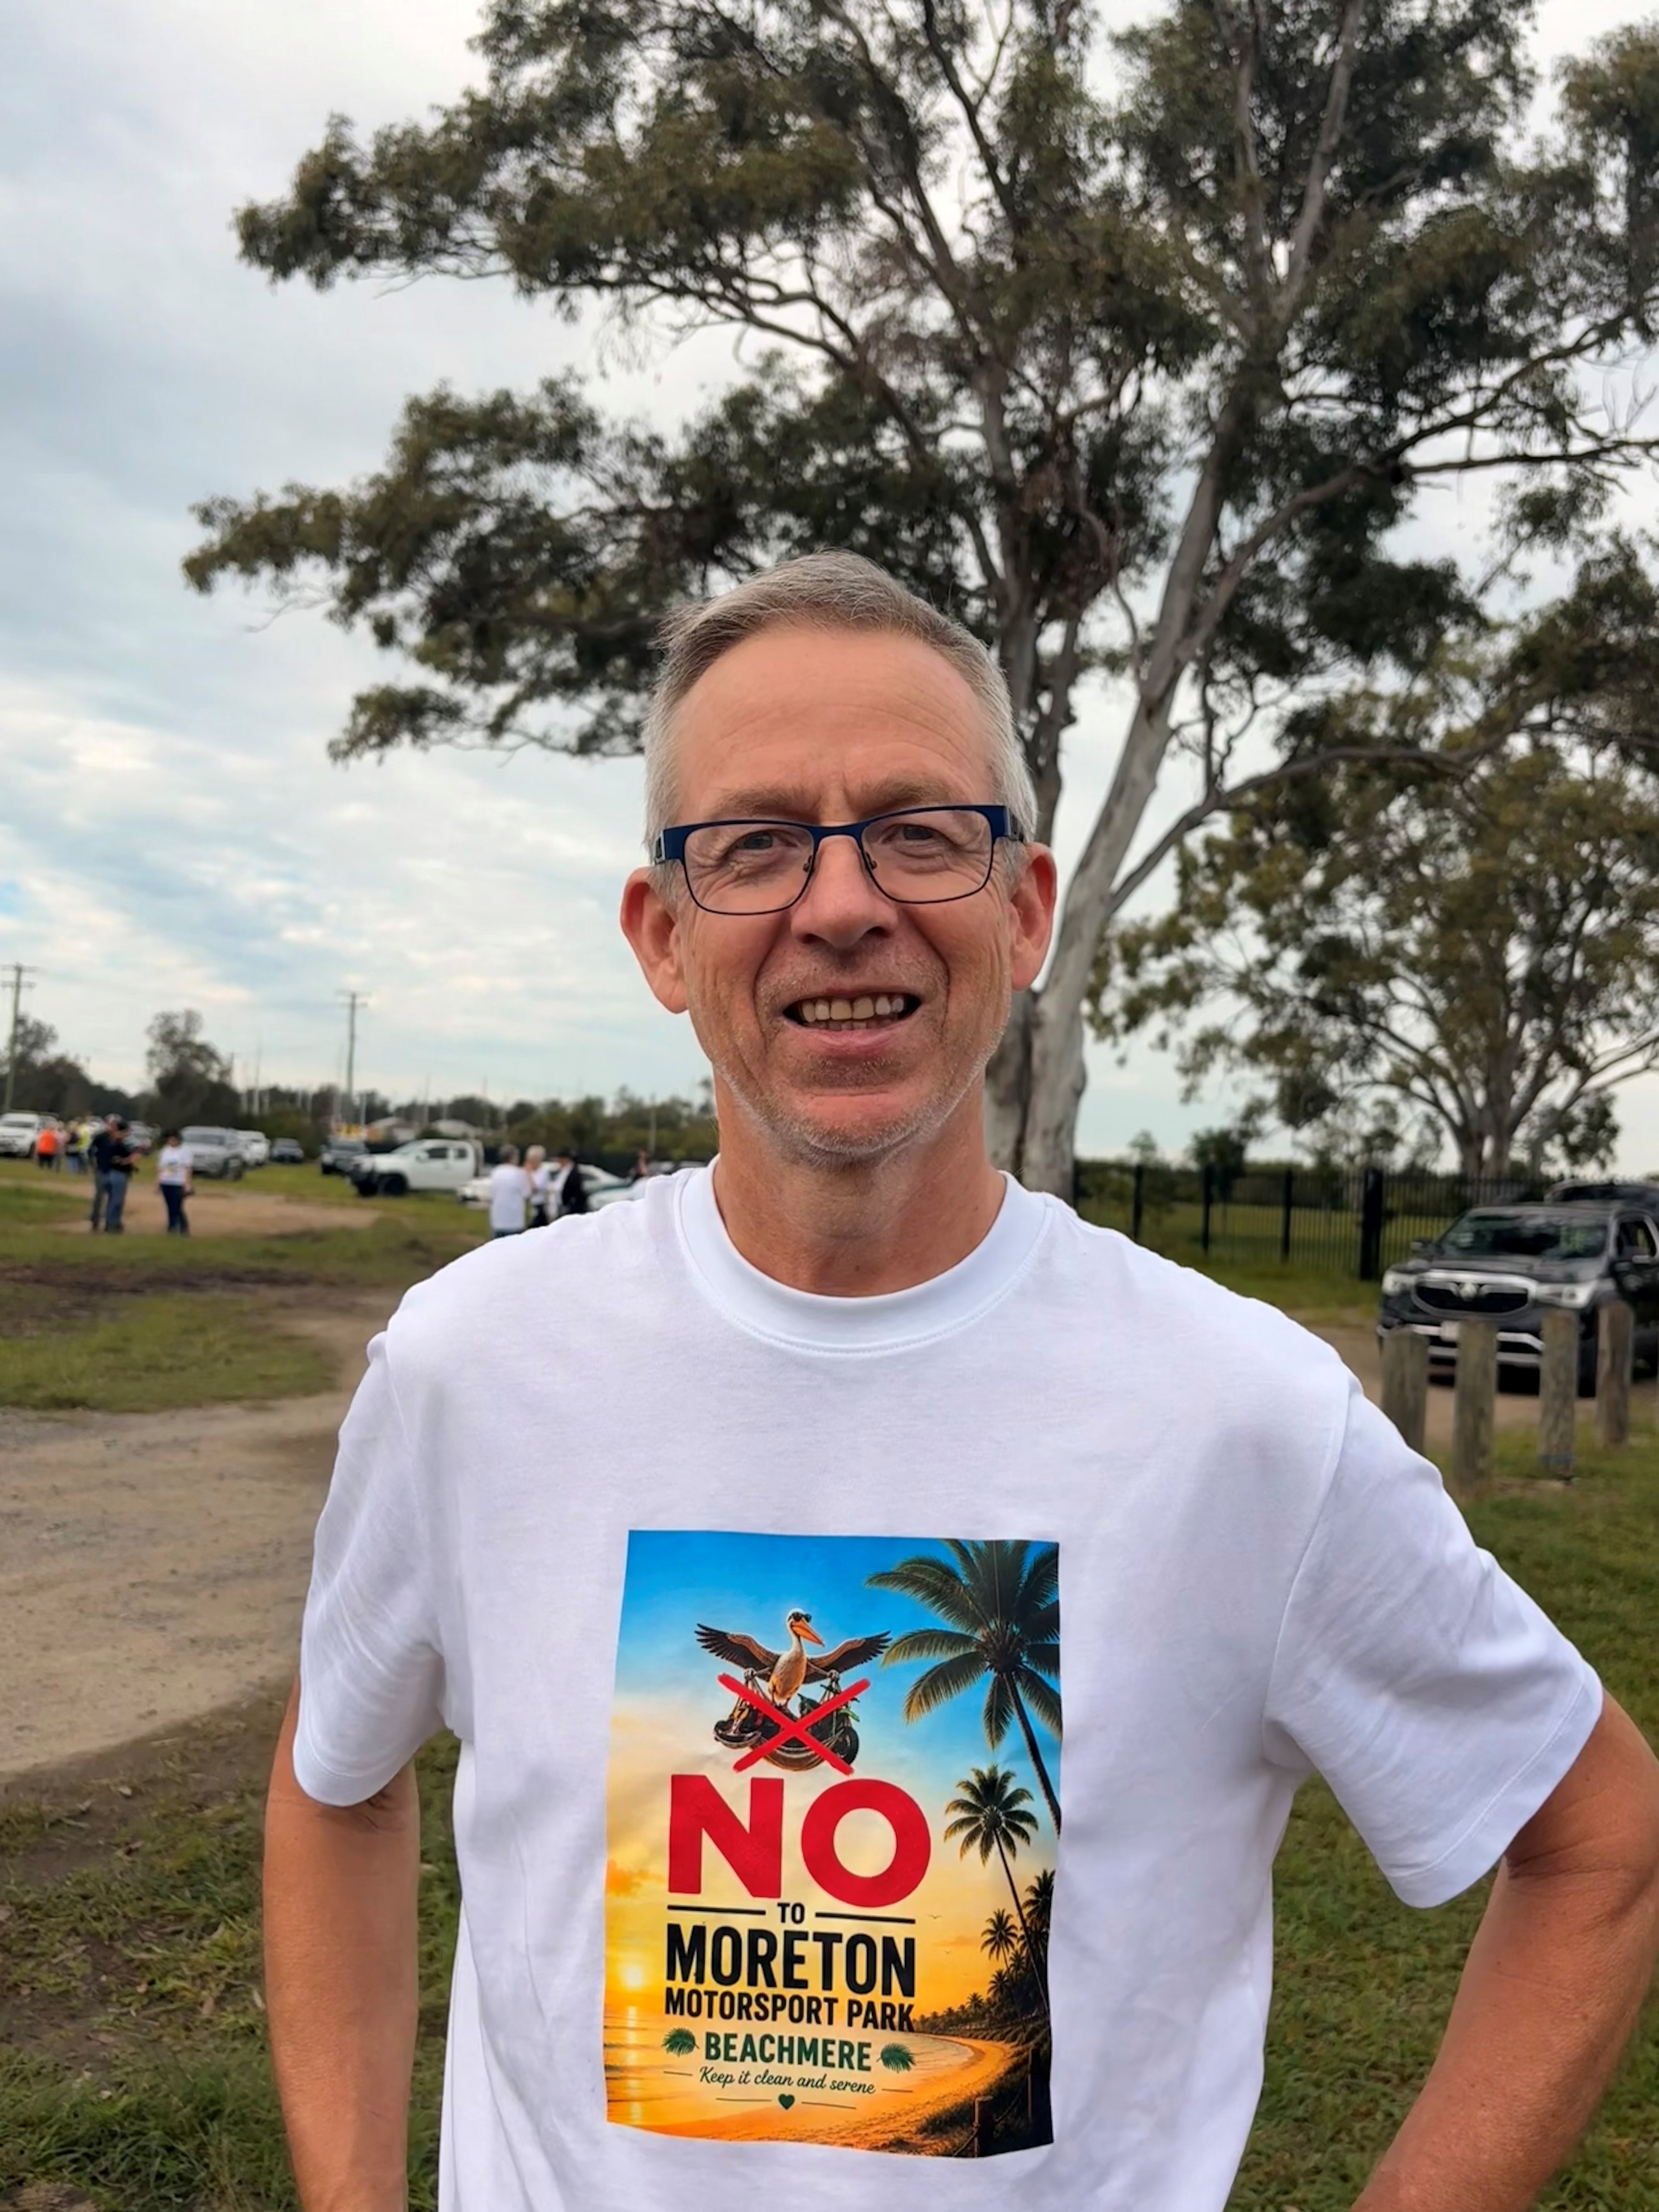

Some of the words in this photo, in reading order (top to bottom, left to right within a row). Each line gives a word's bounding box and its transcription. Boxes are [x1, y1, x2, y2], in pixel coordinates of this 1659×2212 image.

[669, 1774, 931, 1908] NO
[778, 1903, 805, 1923] TO
[667, 1923, 915, 1997] MORETON
[665, 1987, 838, 2025] MOTORSPORT
[847, 1999, 914, 2032] PARK
[705, 2032, 871, 2071] BEACHMERE
[699, 2066, 735, 2088] Keep
[738, 2070, 751, 2084] it
[755, 2069, 793, 2086] clean
[797, 2074, 826, 2089] and
[830, 2080, 876, 2094] serene
